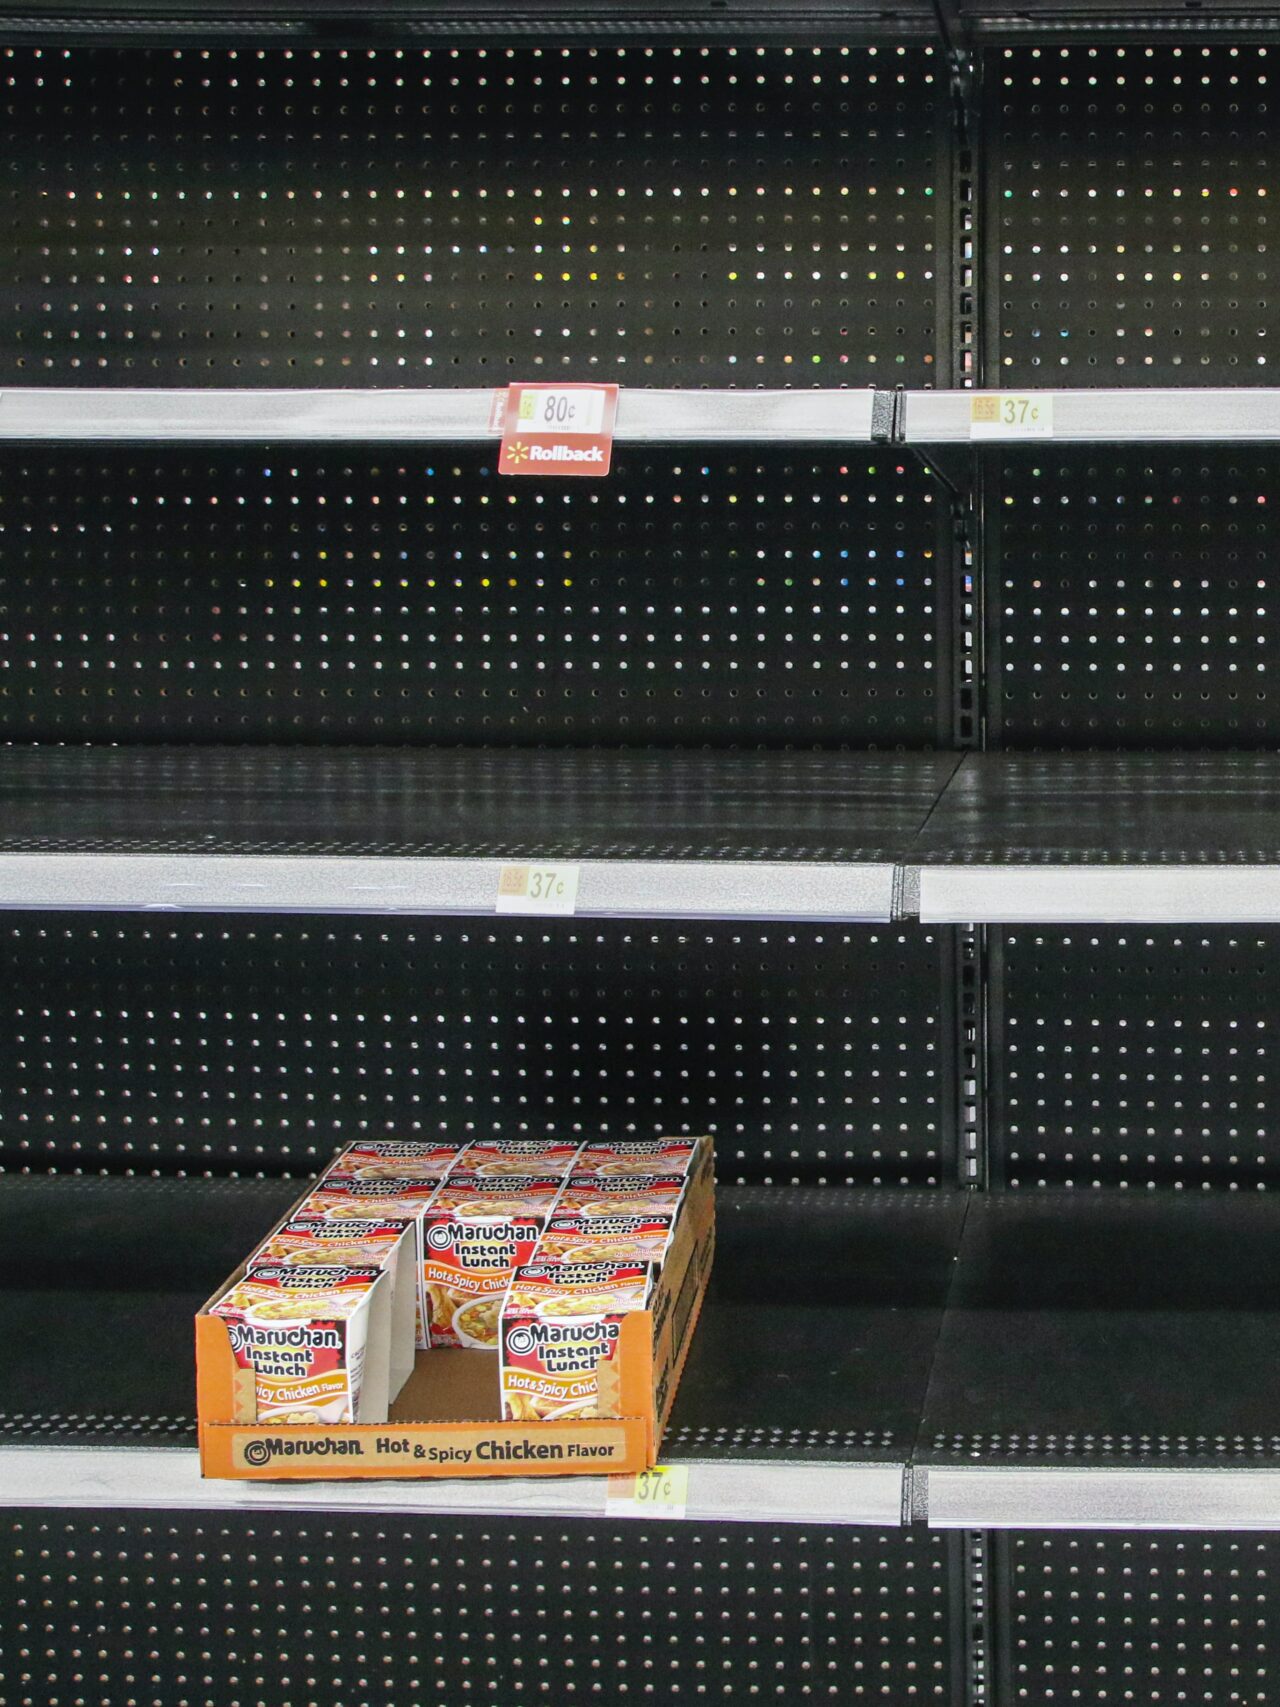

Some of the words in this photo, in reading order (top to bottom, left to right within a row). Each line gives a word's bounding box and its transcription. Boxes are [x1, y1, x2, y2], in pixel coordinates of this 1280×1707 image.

[544, 395, 577, 423] 80¢
[1004, 400, 1039, 424] 37¢
[529, 445, 604, 462] Rollback
[530, 872, 564, 898] 37¢
[574, 1217, 668, 1225] Maruchan
[447, 1222, 537, 1241] Maruchan
[599, 1234, 641, 1244] Chicken
[327, 1238, 371, 1247] Chicken
[455, 1243, 517, 1256] Instant
[463, 1256, 510, 1268] Lunch
[545, 1261, 646, 1272] Maruchan
[279, 1267, 377, 1276] Maruchan
[279, 1275, 346, 1283] Instant
[548, 1270, 618, 1278] Instant
[482, 1276, 511, 1290] Chick
[554, 1276, 608, 1284] Lunch
[294, 1288, 340, 1299] Chicken
[573, 1284, 618, 1295] Chicken
[237, 1325, 338, 1347] Maruchan
[530, 1322, 619, 1342] Marucha
[246, 1345, 313, 1362] Instant
[539, 1342, 609, 1359] Instant
[254, 1361, 307, 1376] Lunch
[276, 1384, 321, 1401] Chicken
[321, 1382, 345, 1392] Flavor
[570, 1377, 598, 1396] Chic
[265, 1437, 364, 1456] Maruchan
[376, 1437, 411, 1454] Hot
[413, 1444, 426, 1459] &
[428, 1446, 472, 1463] Spicy
[476, 1439, 564, 1460] Chicken
[567, 1444, 615, 1458] Flavor
[638, 1471, 672, 1501] 37¢
